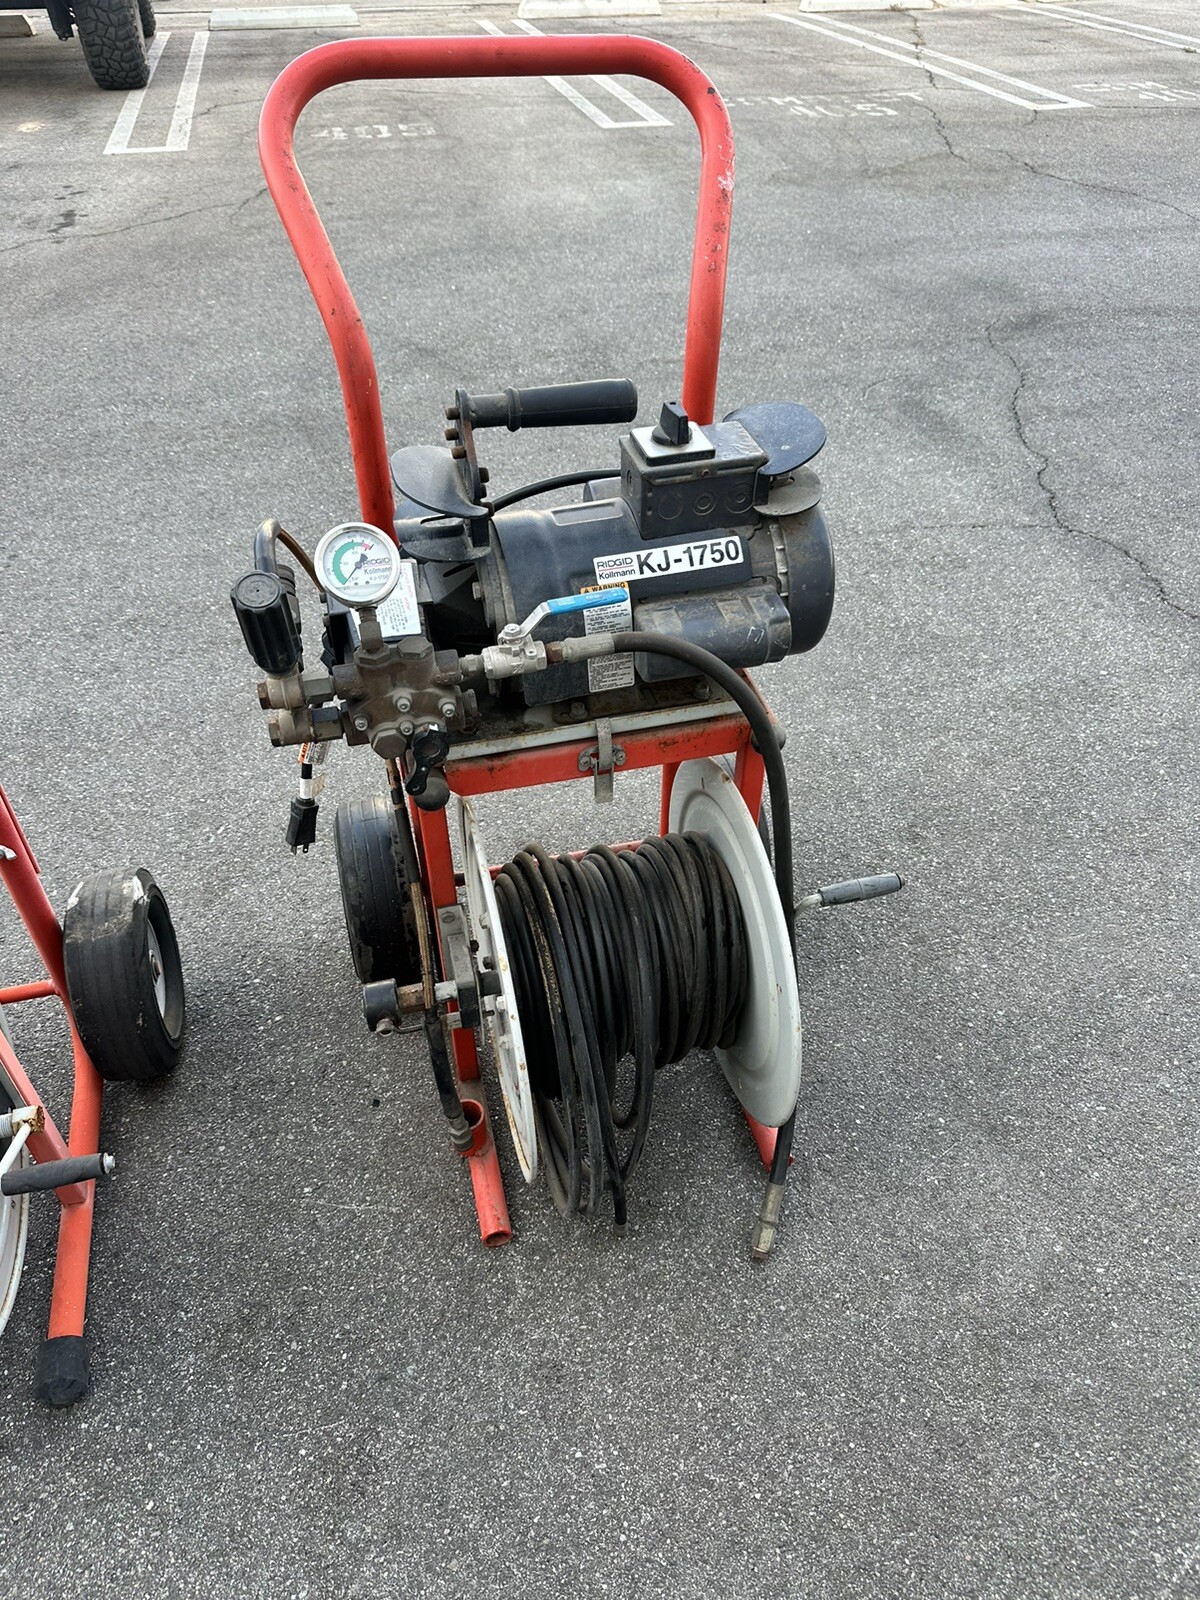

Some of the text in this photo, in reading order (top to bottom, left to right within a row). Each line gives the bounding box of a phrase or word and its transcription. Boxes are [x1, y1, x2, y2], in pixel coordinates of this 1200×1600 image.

[596, 556, 634, 570] RIDGID
[636, 539, 740, 576] KJ-1750
[598, 568, 636, 580] Kollmann
[591, 581, 626, 592] WARNING
